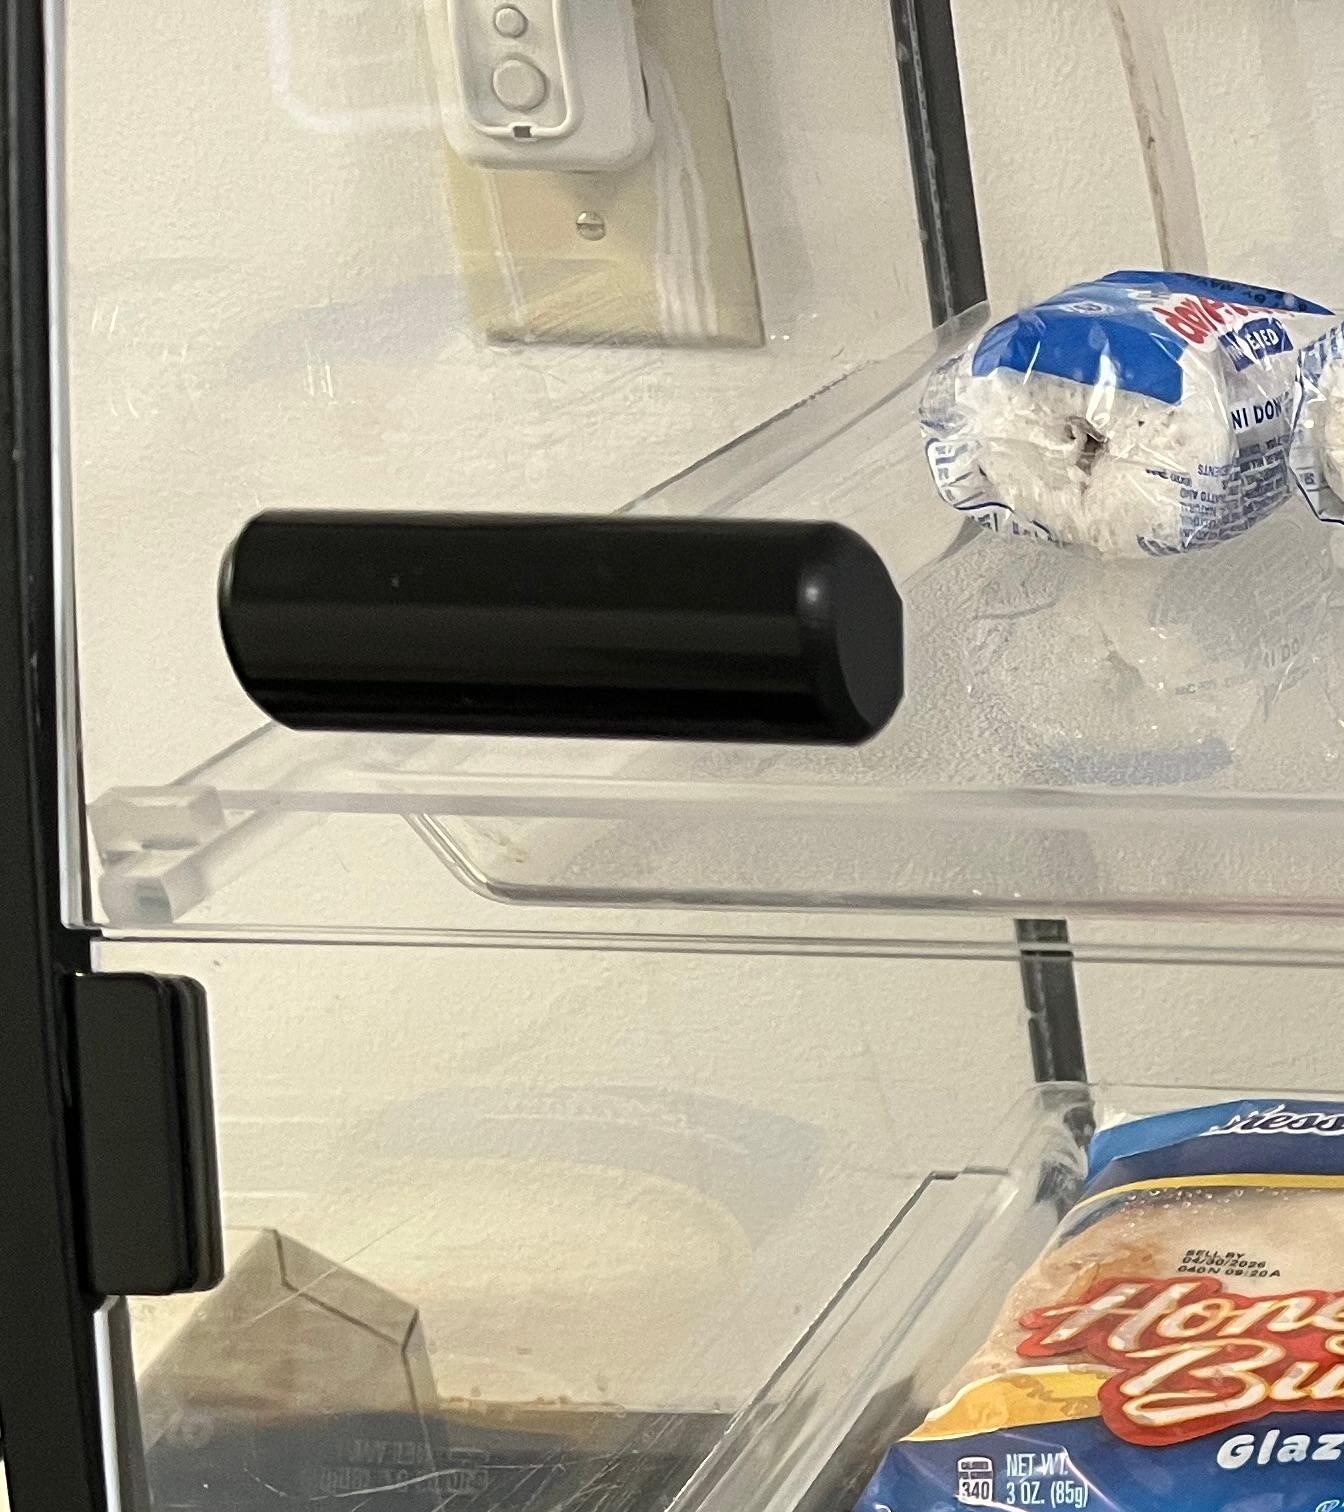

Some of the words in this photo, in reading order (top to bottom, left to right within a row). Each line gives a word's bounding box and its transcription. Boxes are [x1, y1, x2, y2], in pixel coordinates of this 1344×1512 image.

[1006, 1453, 1036, 1477] NET
[1006, 1481, 1016, 1505] 3
[1020, 1481, 1045, 1505] OZ.
[1050, 1480, 1089, 1509] (85g)
